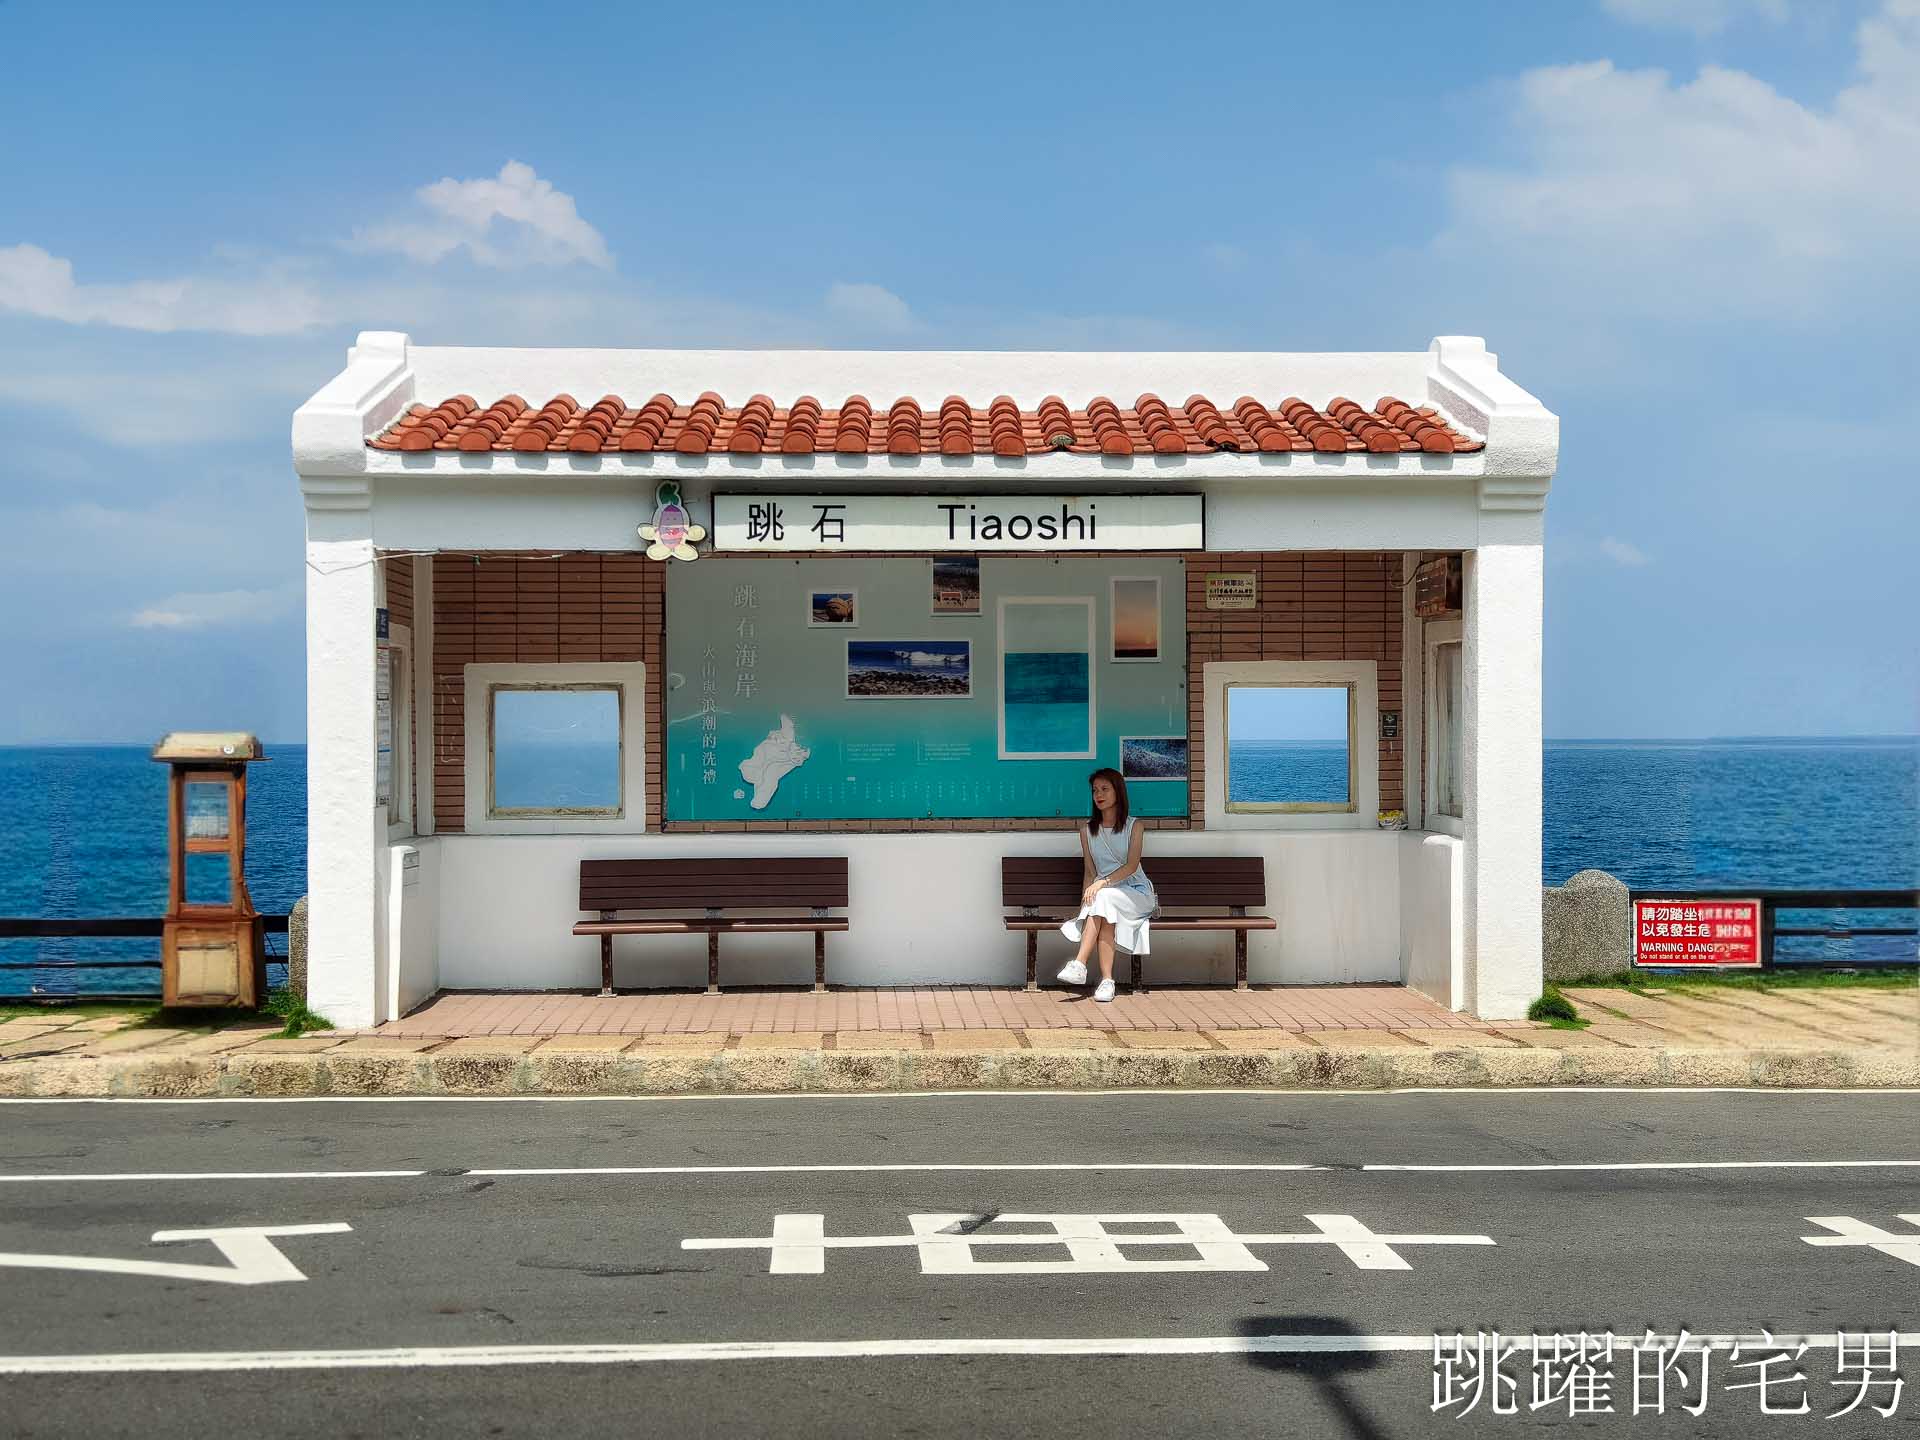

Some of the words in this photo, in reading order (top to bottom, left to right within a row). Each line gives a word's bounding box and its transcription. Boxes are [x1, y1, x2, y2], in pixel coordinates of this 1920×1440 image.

[747, 502, 846, 543] 跳石
[937, 503, 1097, 542] Tiaoshi
[1640, 942, 1684, 952] WARNING
